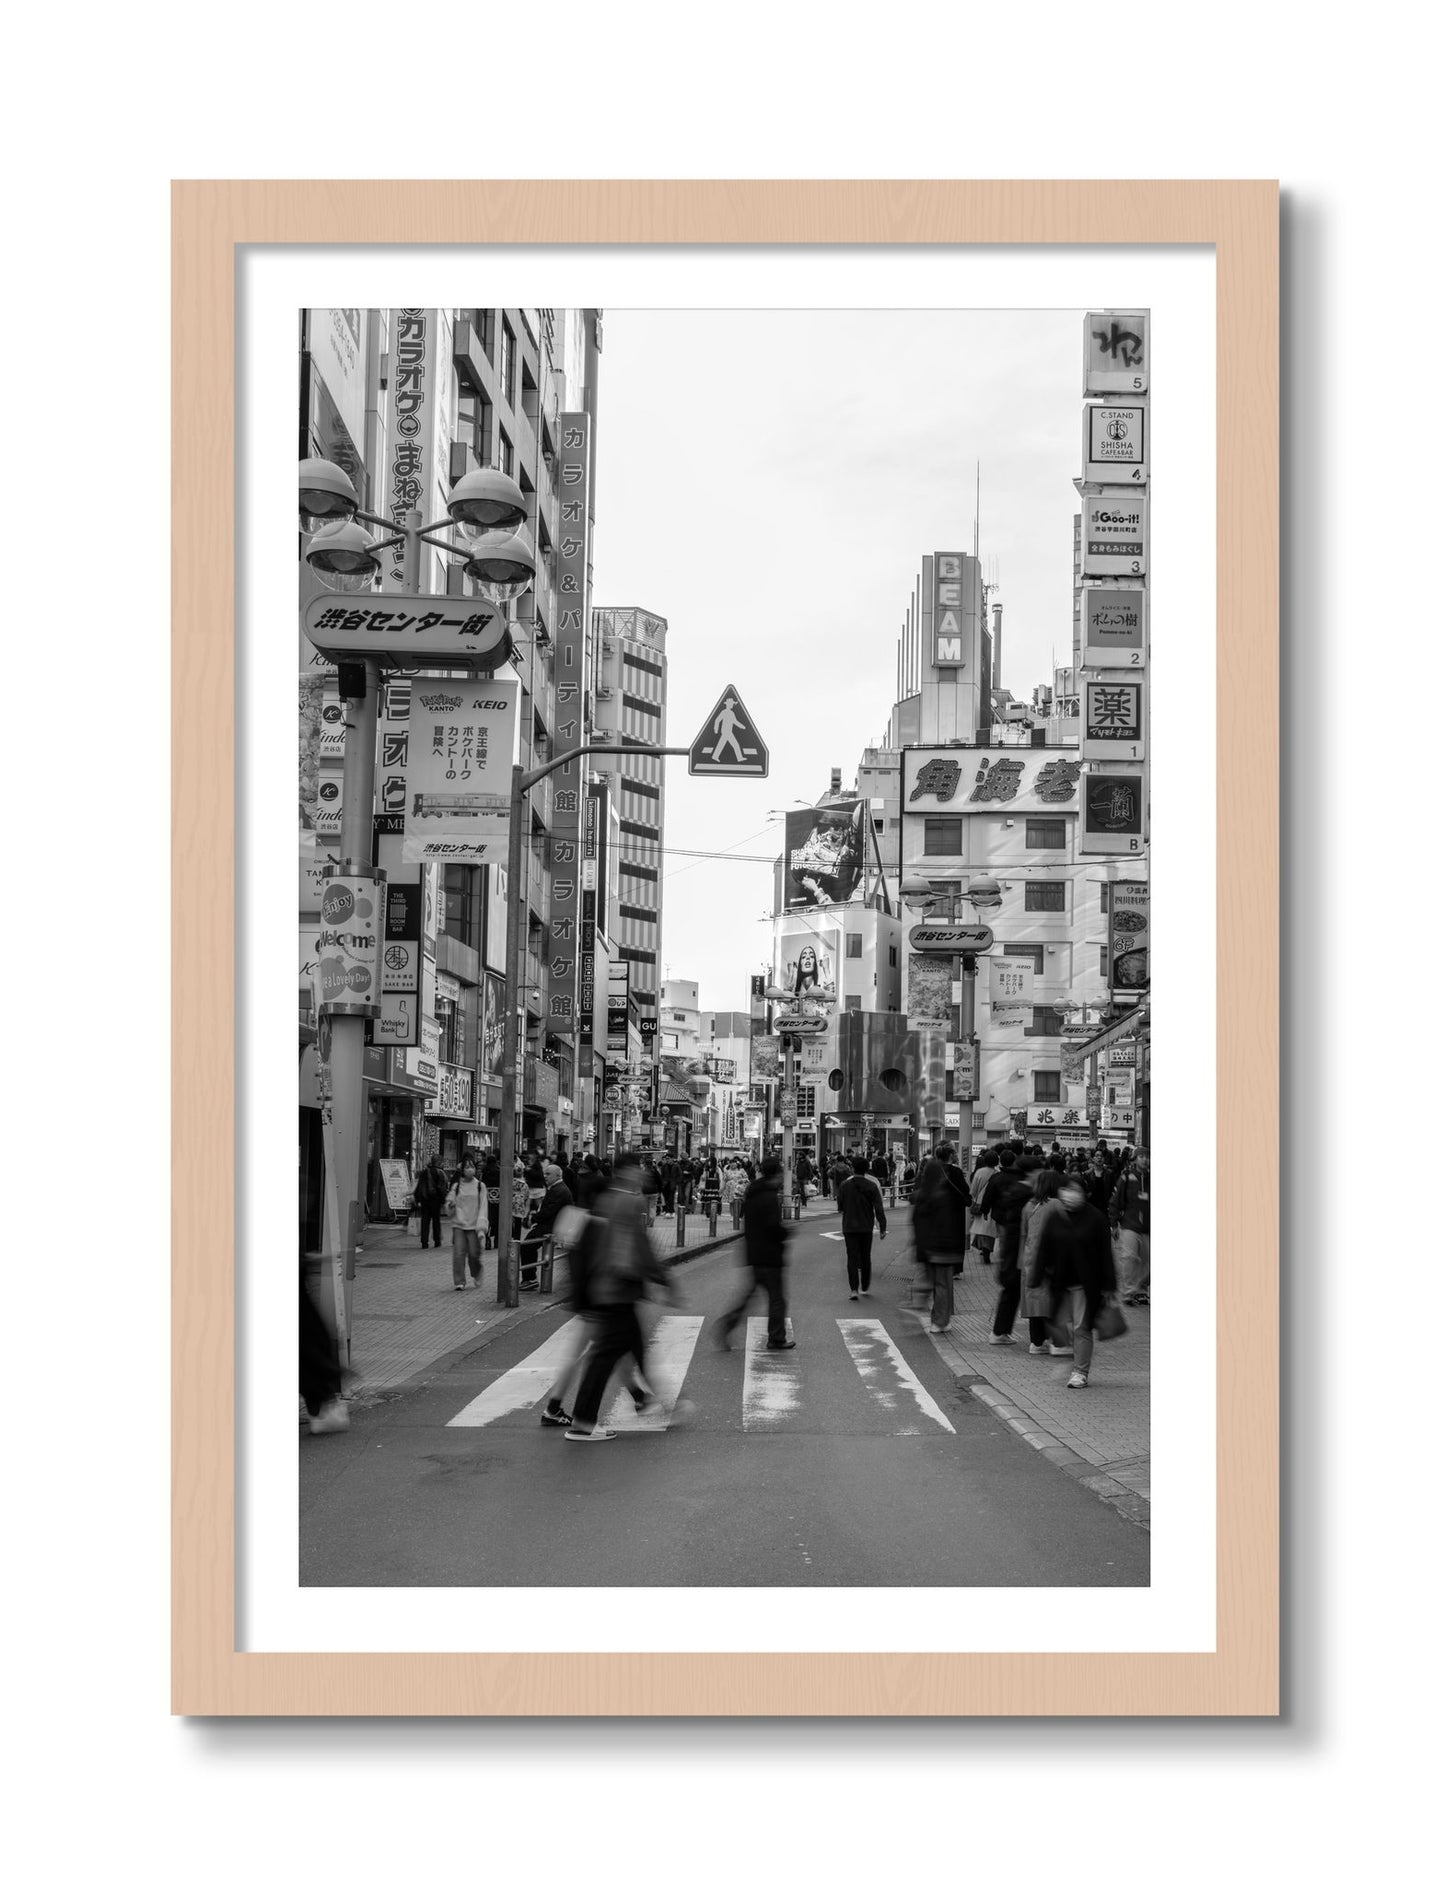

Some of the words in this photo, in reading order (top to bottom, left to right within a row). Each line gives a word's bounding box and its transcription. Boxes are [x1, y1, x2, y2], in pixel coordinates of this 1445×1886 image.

[396, 316, 426, 415] カラオケ
[1133, 377, 1143, 389] 5
[1100, 411, 1134, 419] C.STAND
[1100, 441, 1134, 449] SHISHA
[1131, 560, 1140, 573] 3
[937, 556, 962, 661] BEAM
[313, 607, 495, 637] 渋谷センター街
[1130, 652, 1140, 665] 2
[472, 699, 508, 711] KEIO
[1094, 688, 1131, 726] 薬
[432, 725, 444, 757] 冒険へ
[445, 725, 459, 780] カントーの
[475, 726, 489, 770] 京王線で
[1130, 745, 1137, 758] 1
[909, 757, 1082, 802] 角海老
[423, 843, 488, 853] 渋谷センター街
[1129, 838, 1139, 851] B
[322, 894, 353, 919] Enjoy
[320, 930, 376, 949] Welcome
[914, 931, 988, 942] 渋谷センター街
[1113, 937, 1135, 952] 6F
[333, 973, 355, 987] Lovely
[380, 1026, 396, 1034] Bank
[381, 1019, 405, 1029] Whisky
[641, 1022, 657, 1031] GU
